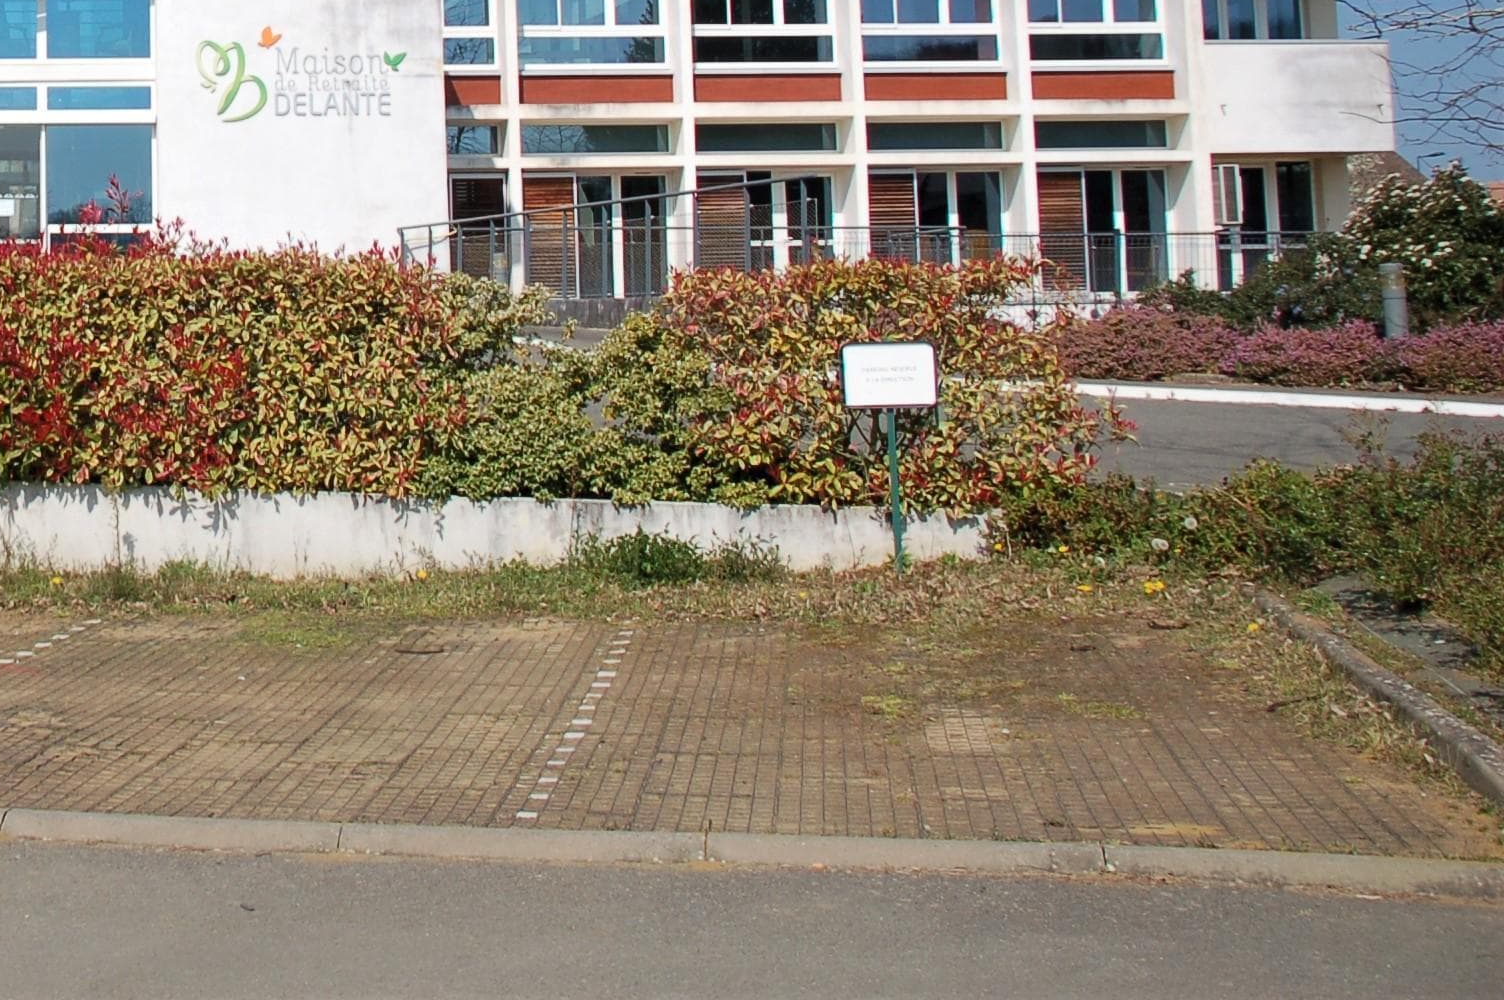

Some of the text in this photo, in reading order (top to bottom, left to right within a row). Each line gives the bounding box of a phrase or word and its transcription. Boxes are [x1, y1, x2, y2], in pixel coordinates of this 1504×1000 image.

[275, 47, 389, 75] Maison
[275, 74, 390, 91] de Retraite
[275, 93, 391, 117] DELANTE
